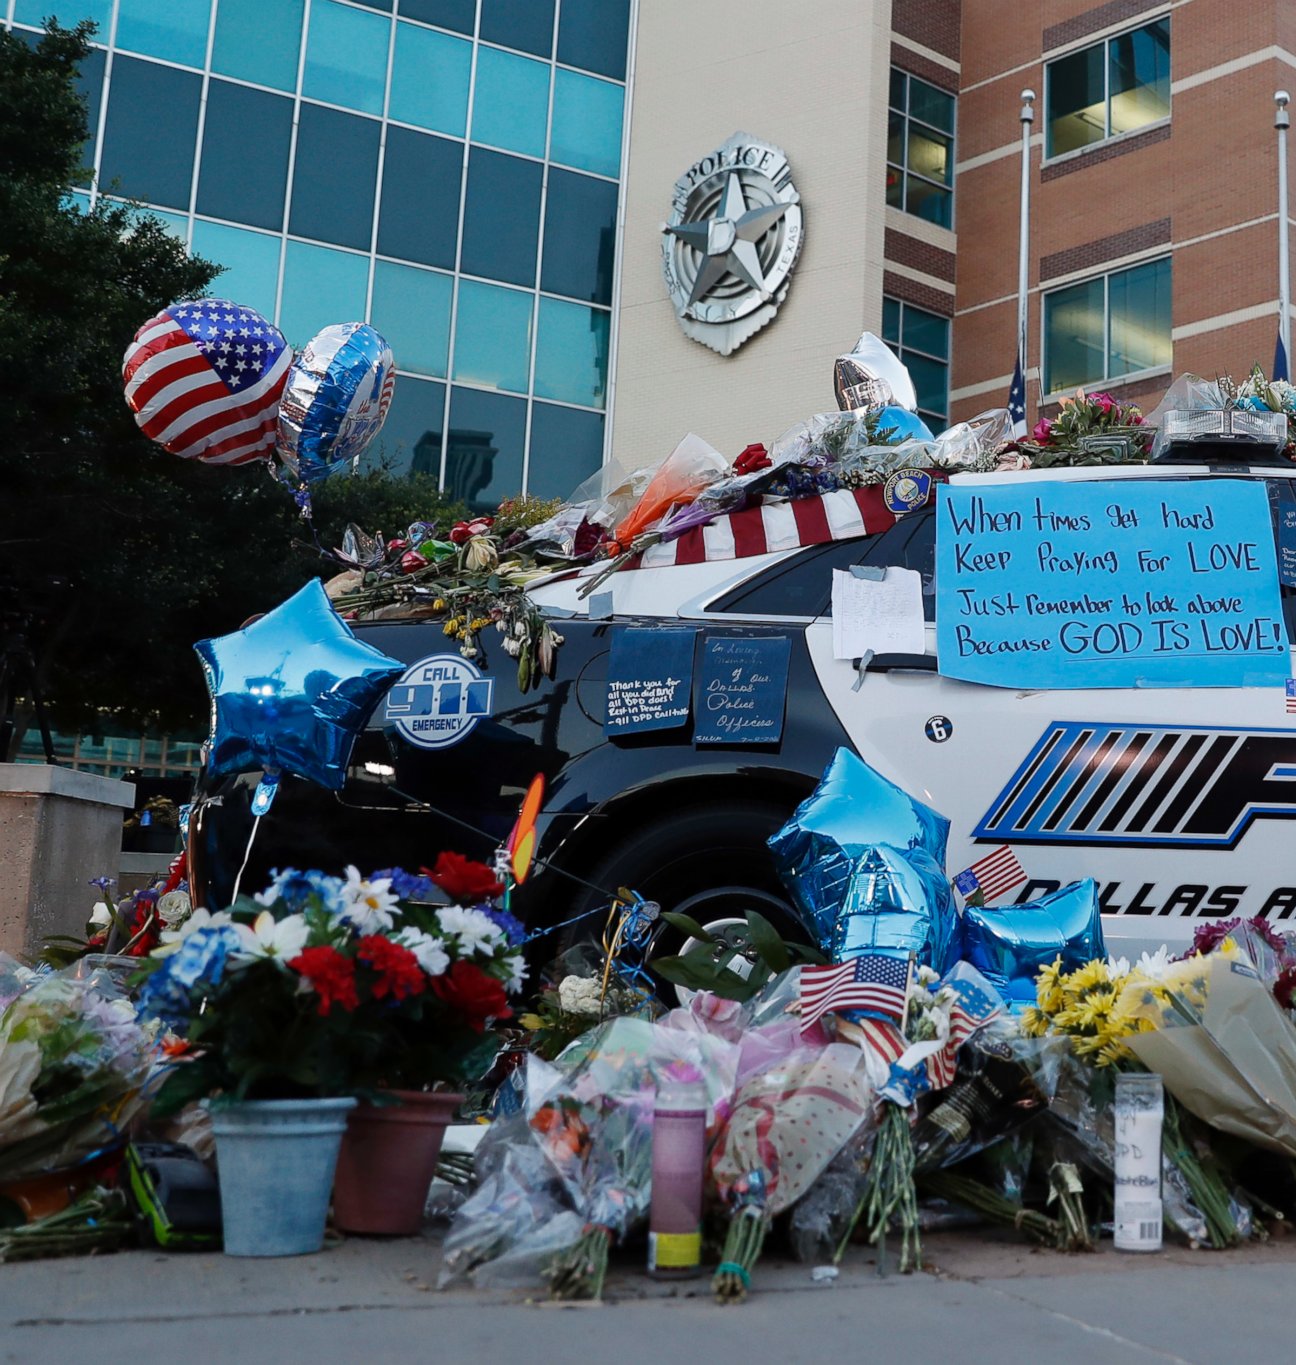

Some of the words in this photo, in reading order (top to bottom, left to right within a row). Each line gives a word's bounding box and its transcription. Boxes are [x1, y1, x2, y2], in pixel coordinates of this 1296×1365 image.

[686, 145, 775, 186] POLICE
[776, 224, 798, 274] TEXAS
[900, 470, 923, 480] BEACH
[886, 476, 901, 505] NEWPORT
[907, 491, 927, 510] POLICE
[947, 496, 1021, 536] When
[1032, 497, 1091, 532] times
[1106, 504, 1139, 530] get
[1162, 502, 1214, 530] hard
[955, 543, 1012, 575] Keep
[1037, 541, 1118, 576] Praying
[1138, 549, 1171, 572] For
[1187, 542, 1260, 572] LOVE
[959, 588, 1020, 616] Just
[1025, 593, 1113, 615] remember
[1122, 591, 1141, 614] to
[1147, 591, 1179, 614] look
[1188, 593, 1244, 614] above
[956, 625, 1052, 657] Because
[1060, 621, 1143, 654] GOD
[1151, 620, 1190, 653] IS
[1200, 618, 1285, 654] LOVE!
[423, 667, 460, 681] CALL
[609, 680, 641, 692] Thank
[643, 680, 662, 690] you
[666, 677, 681, 687] for
[386, 678, 493, 720] 911
[608, 691, 620, 700] all
[622, 691, 640, 701] you
[641, 689, 655, 698] did
[608, 699, 621, 708] all
[707, 692, 755, 711] Police
[412, 718, 464, 732] EMERGENCY
[632, 714, 652, 723] DPD
[716, 715, 774, 733] Officers
[931, 719, 947, 741] 6
[1014, 879, 1248, 917] DLLAS
